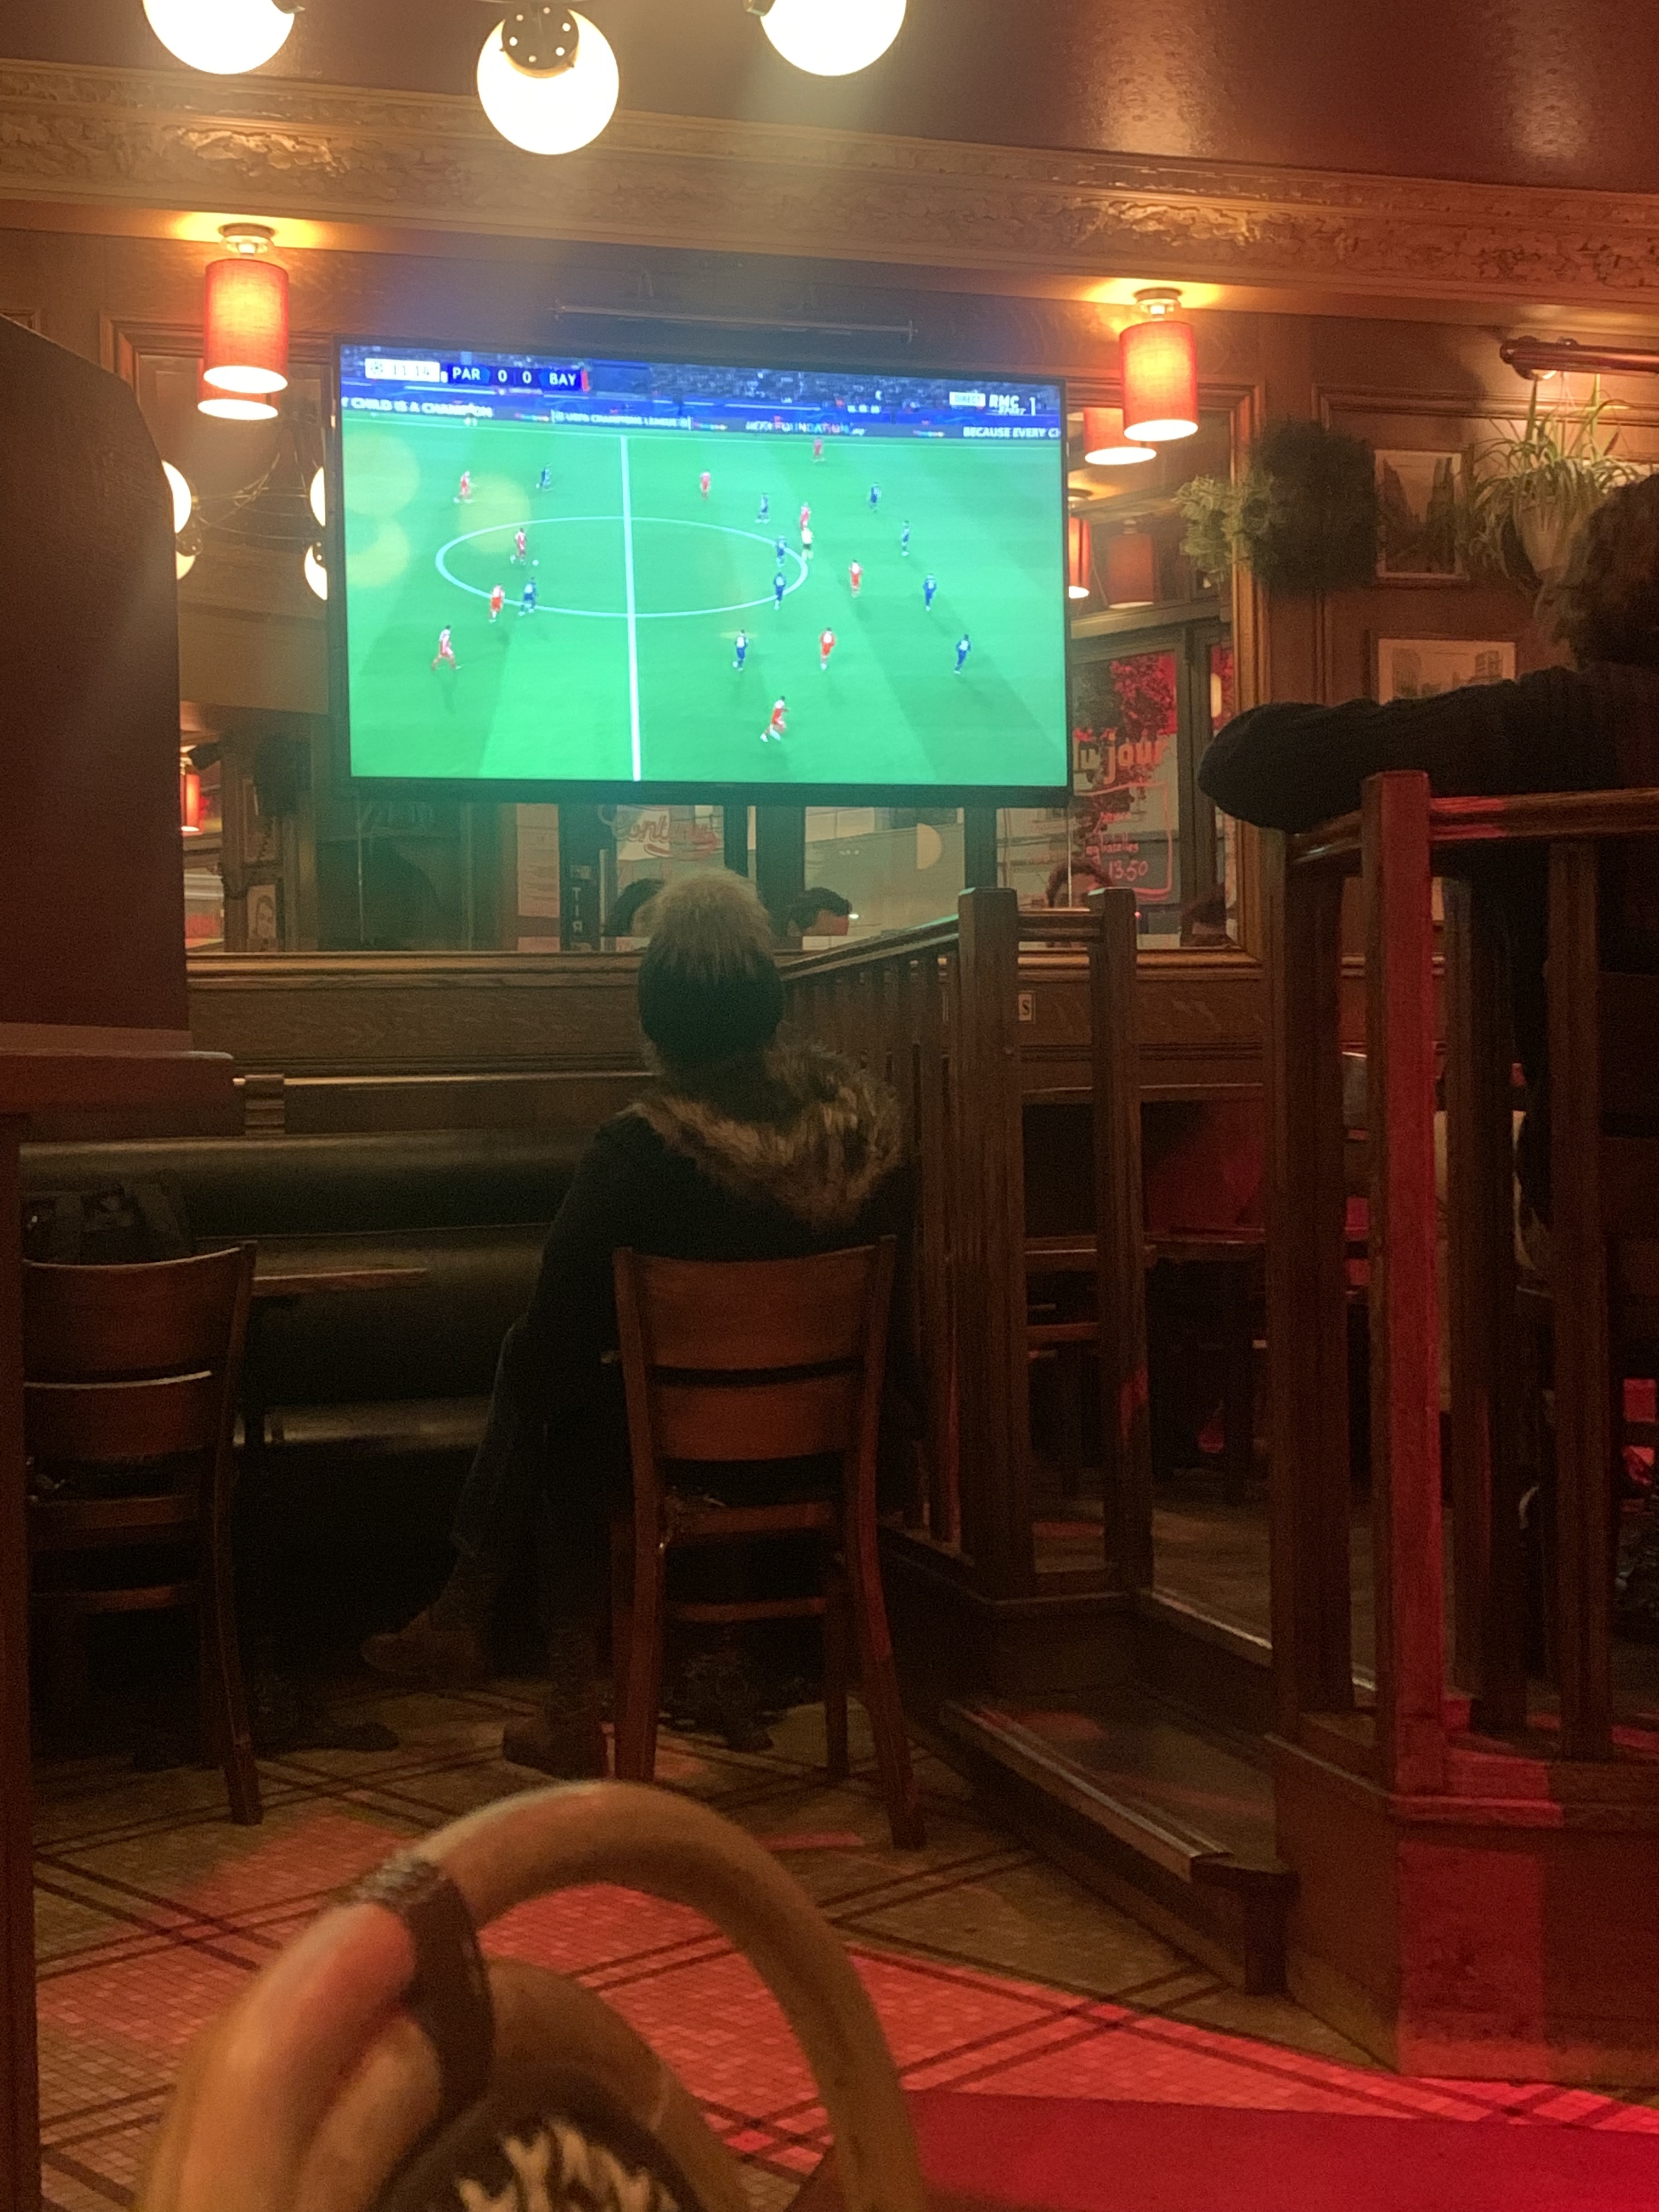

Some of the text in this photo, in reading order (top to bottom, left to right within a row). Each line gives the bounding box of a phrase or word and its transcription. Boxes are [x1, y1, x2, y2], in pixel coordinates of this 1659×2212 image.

[452, 368, 577, 387] PAR 0 0 BAY
[955, 394, 980, 404] DIRECT
[989, 394, 1020, 409] RMC
[963, 426, 1011, 438] BECAUSE
[1013, 427, 1046, 438] EVERY
